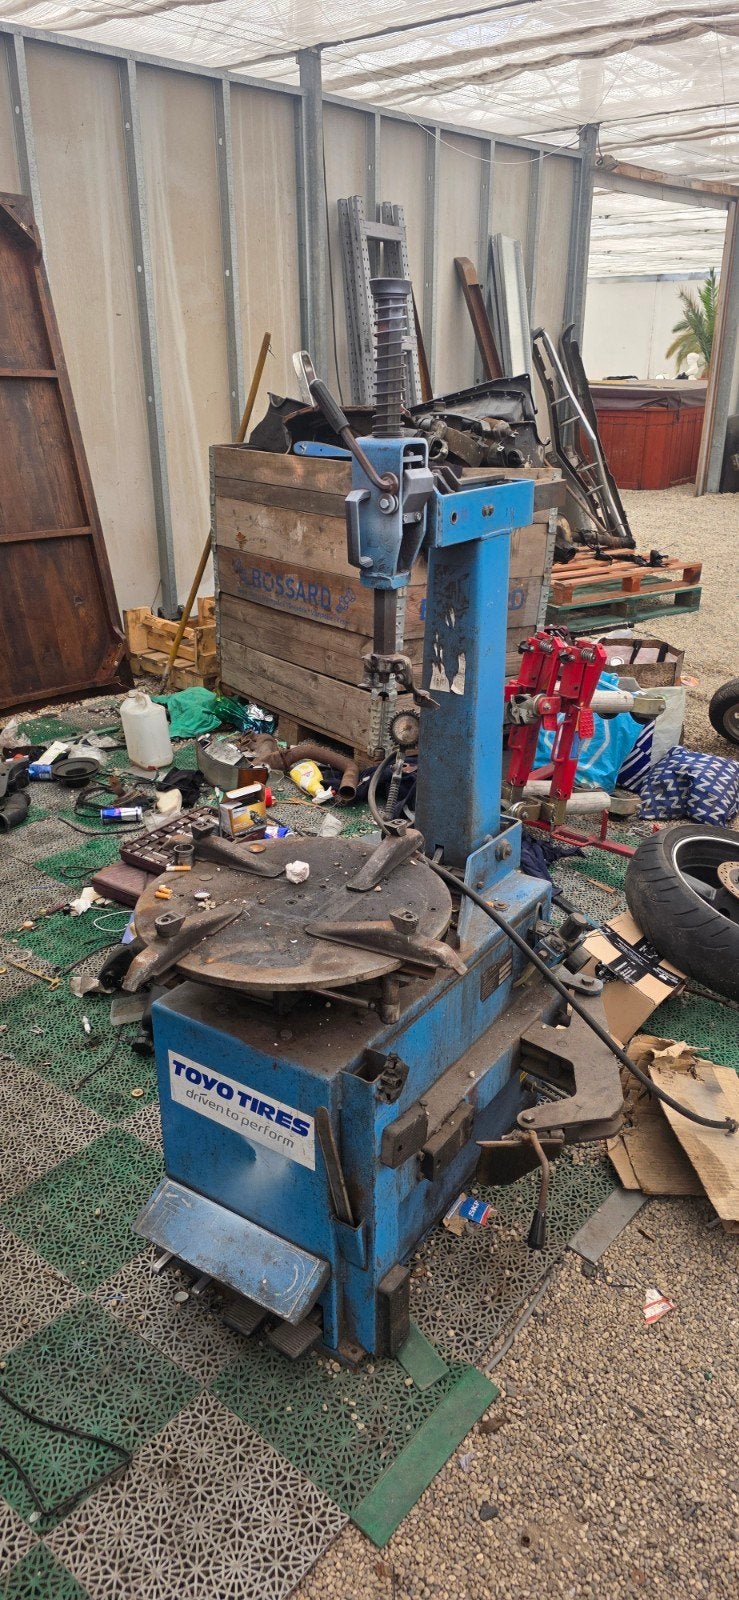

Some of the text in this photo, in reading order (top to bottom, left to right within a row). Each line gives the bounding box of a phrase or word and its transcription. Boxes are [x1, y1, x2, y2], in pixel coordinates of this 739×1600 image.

[251, 568, 333, 611] BOSSARD
[173, 1059, 311, 1137] TOYO TIRES
[186, 1088, 295, 1149] driven to perform
